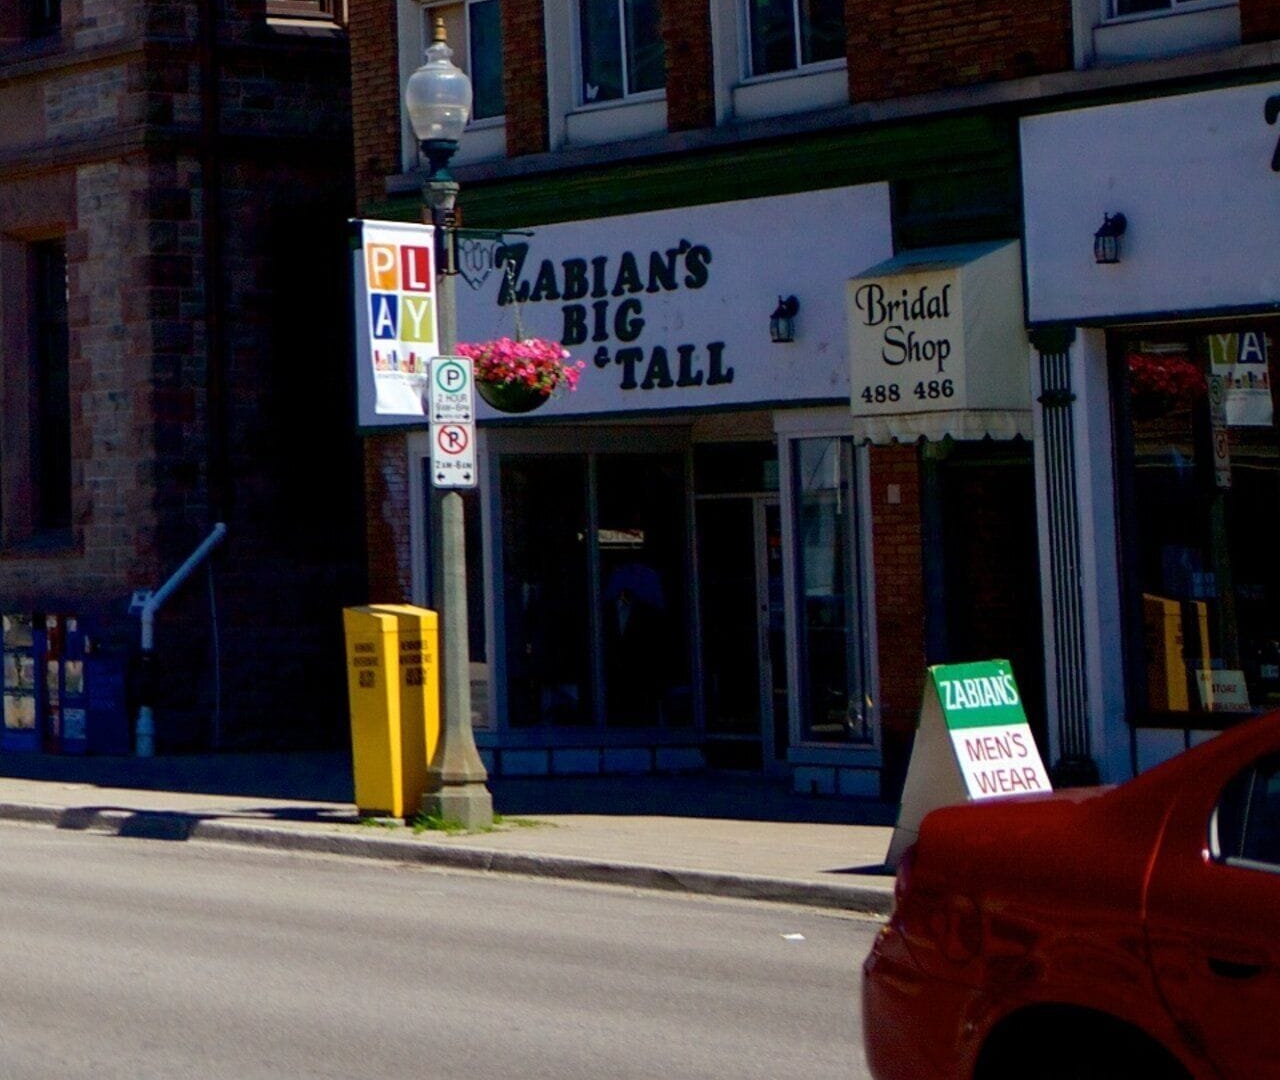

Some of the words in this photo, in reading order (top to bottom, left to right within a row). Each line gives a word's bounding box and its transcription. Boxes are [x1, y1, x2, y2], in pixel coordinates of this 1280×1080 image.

[494, 239, 712, 306] ZABIAN'S
[855, 283, 952, 326] Bridal
[561, 298, 646, 356] BIG
[615, 341, 735, 390] TALL
[882, 325, 952, 374] Shop
[861, 382, 901, 404] 488
[913, 379, 954, 400] 486
[940, 670, 1019, 710] ZABIAN'S
[965, 731, 1028, 762] MEN'S
[973, 766, 1041, 794] WEAR
